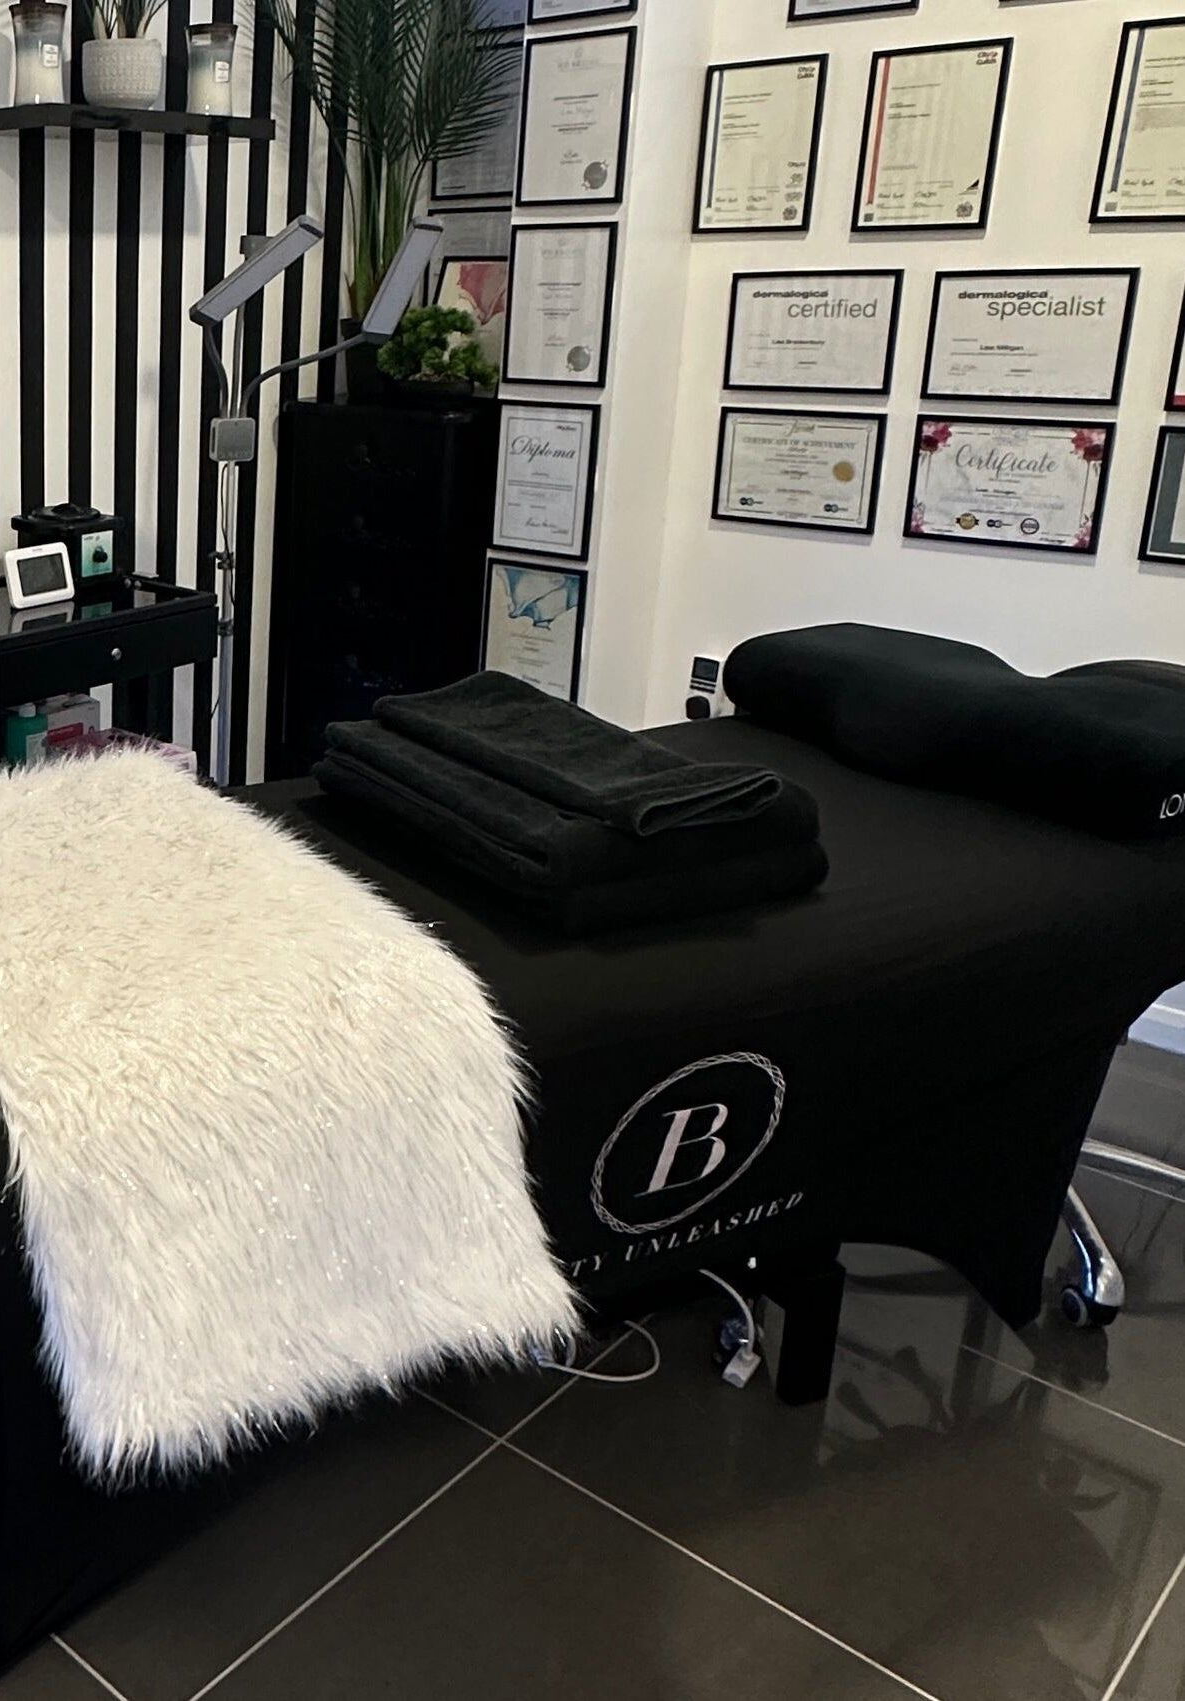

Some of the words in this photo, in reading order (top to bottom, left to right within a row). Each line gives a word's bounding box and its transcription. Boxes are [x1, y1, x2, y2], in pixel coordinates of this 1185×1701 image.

[752, 290, 829, 299] dermalogica
[958, 290, 1049, 300] dermalogica
[787, 298, 878, 318] certified
[986, 296, 1107, 321] specialist
[509, 435, 576, 463] Diploma
[955, 443, 1059, 478] Certificate
[1159, 793, 1185, 819] LO
[633, 1102, 729, 1198] B
[624, 1191, 805, 1263] UNLEASHED
